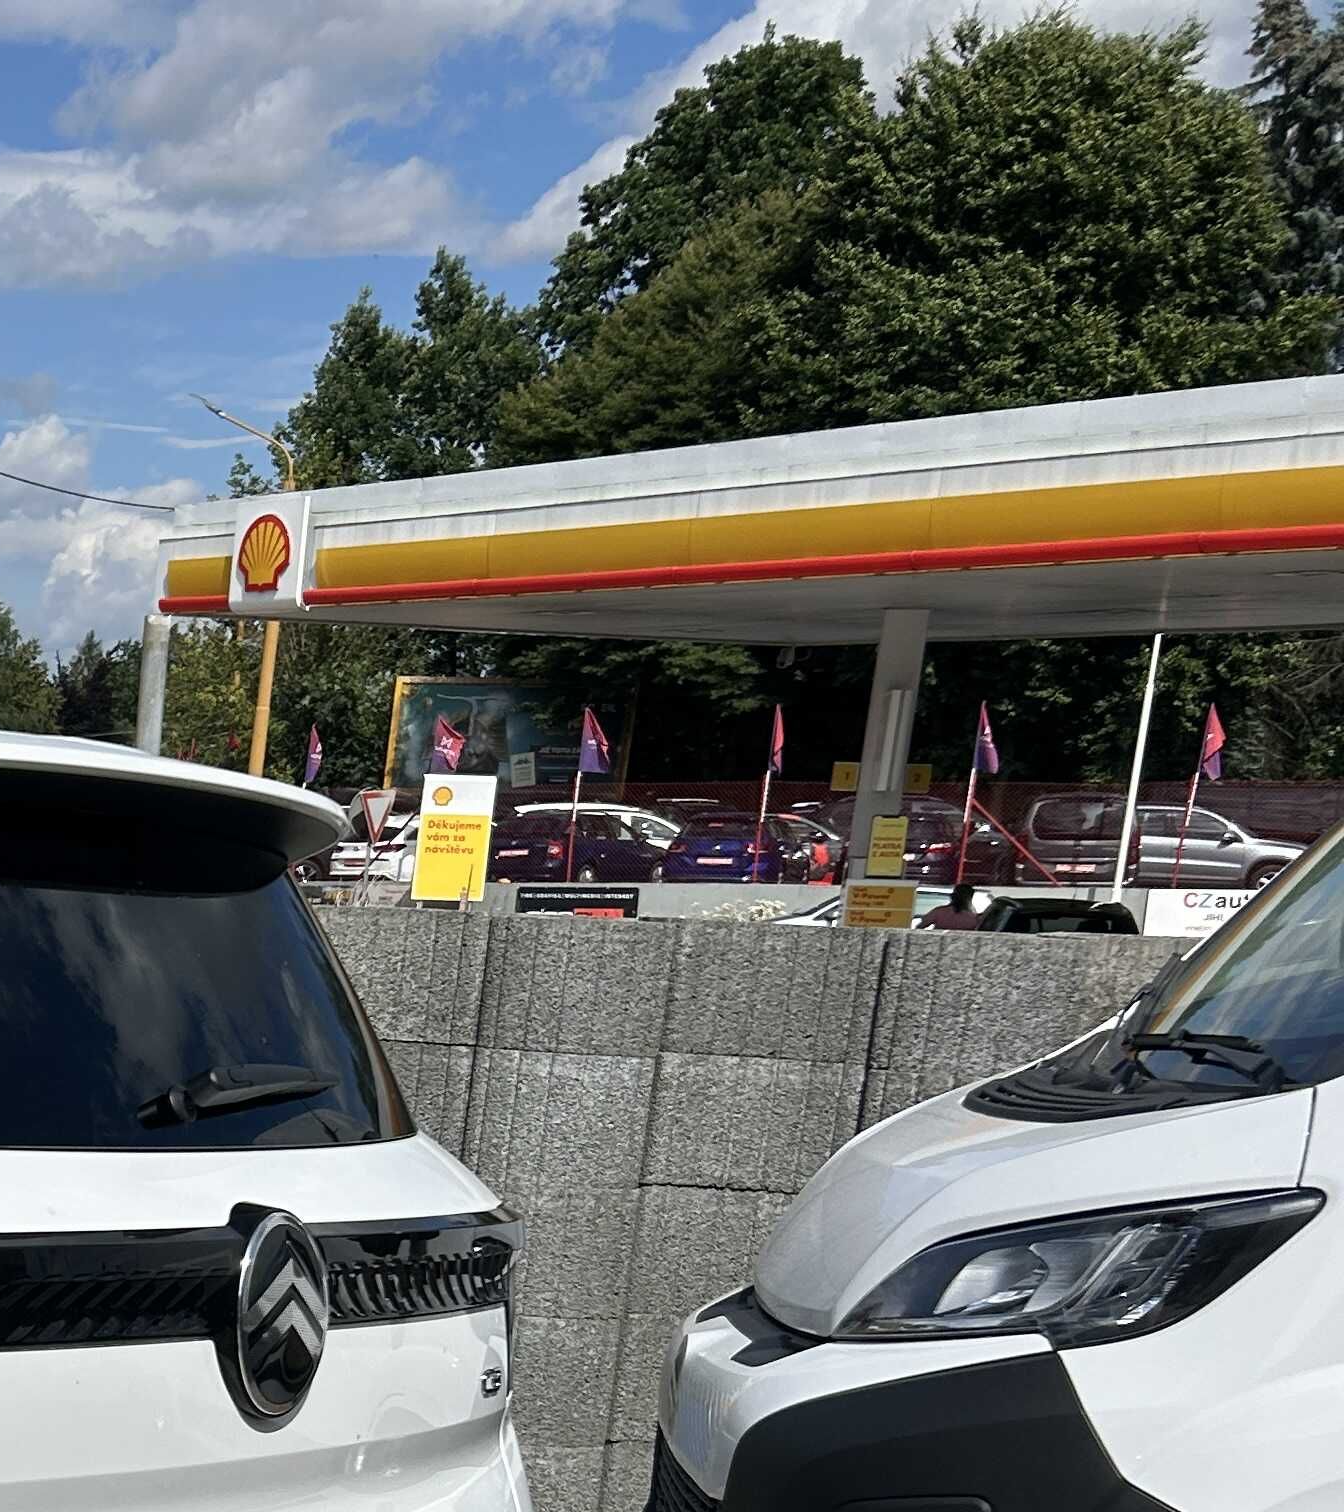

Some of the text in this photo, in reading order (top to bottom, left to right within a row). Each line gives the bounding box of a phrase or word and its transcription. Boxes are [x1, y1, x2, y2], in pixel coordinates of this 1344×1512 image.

[427, 819, 482, 833] Děkujeme
[426, 832, 466, 843] vám za
[424, 843, 475, 855] návštěvu
